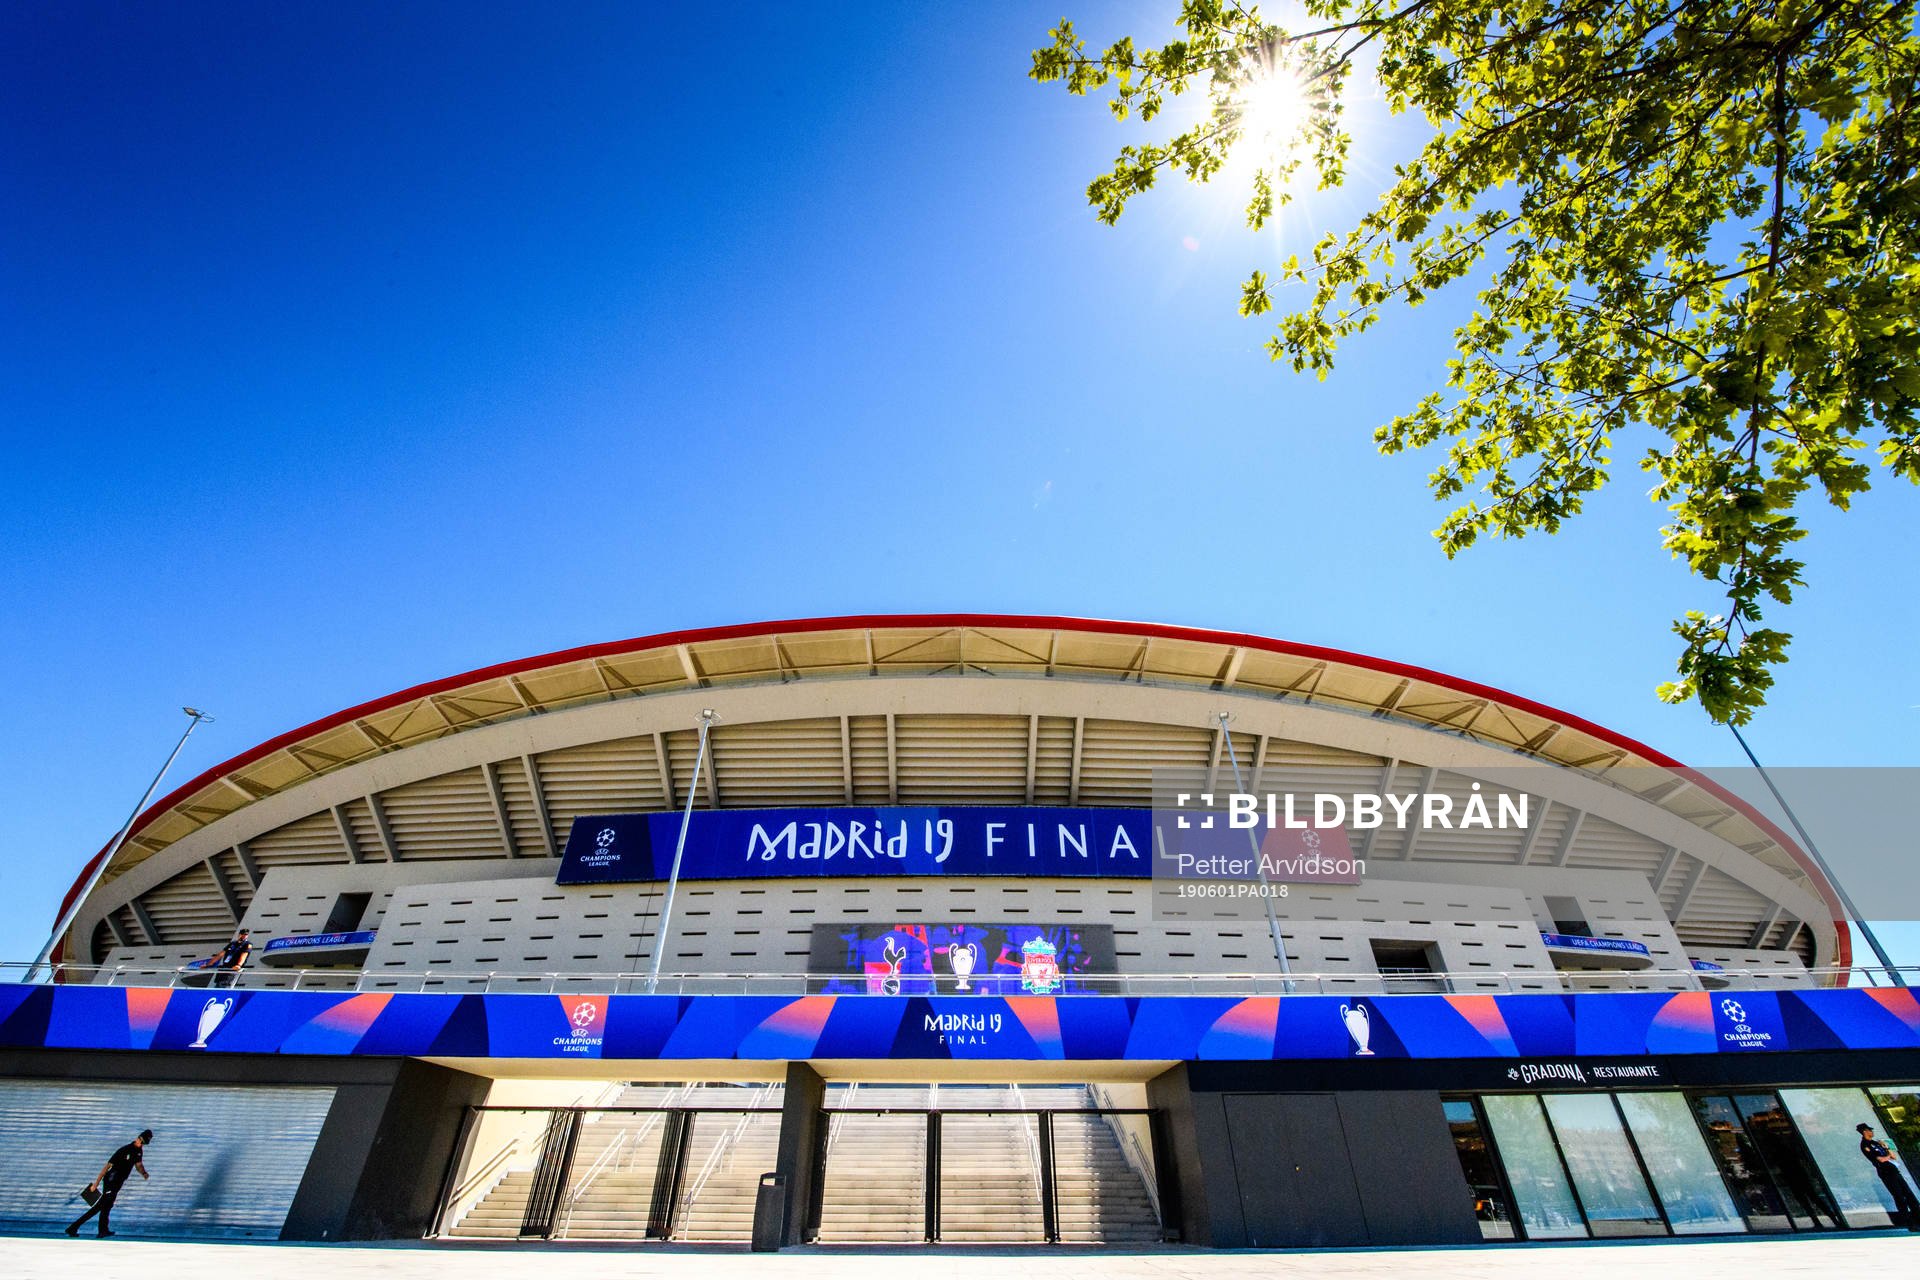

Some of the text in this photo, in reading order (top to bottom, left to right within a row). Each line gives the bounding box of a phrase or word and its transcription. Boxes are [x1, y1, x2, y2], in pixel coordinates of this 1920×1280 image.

[925, 819, 954, 863] 19
[986, 823, 1180, 859] FINAL
[285, 936, 320, 946] CHAMPIONS
[321, 935, 347, 944] LEAGUE
[1571, 938, 1590, 946] UEFA
[1591, 940, 1626, 950] CHAMPIONS
[990, 1014, 1002, 1033] 19
[553, 1037, 602, 1045] CHAMPIONS
[939, 1035, 987, 1045] FINAL
[1724, 1033, 1771, 1041] CHAMPIONS
[1507, 1064, 1660, 1084] La GRADONA RESTAURANTE
